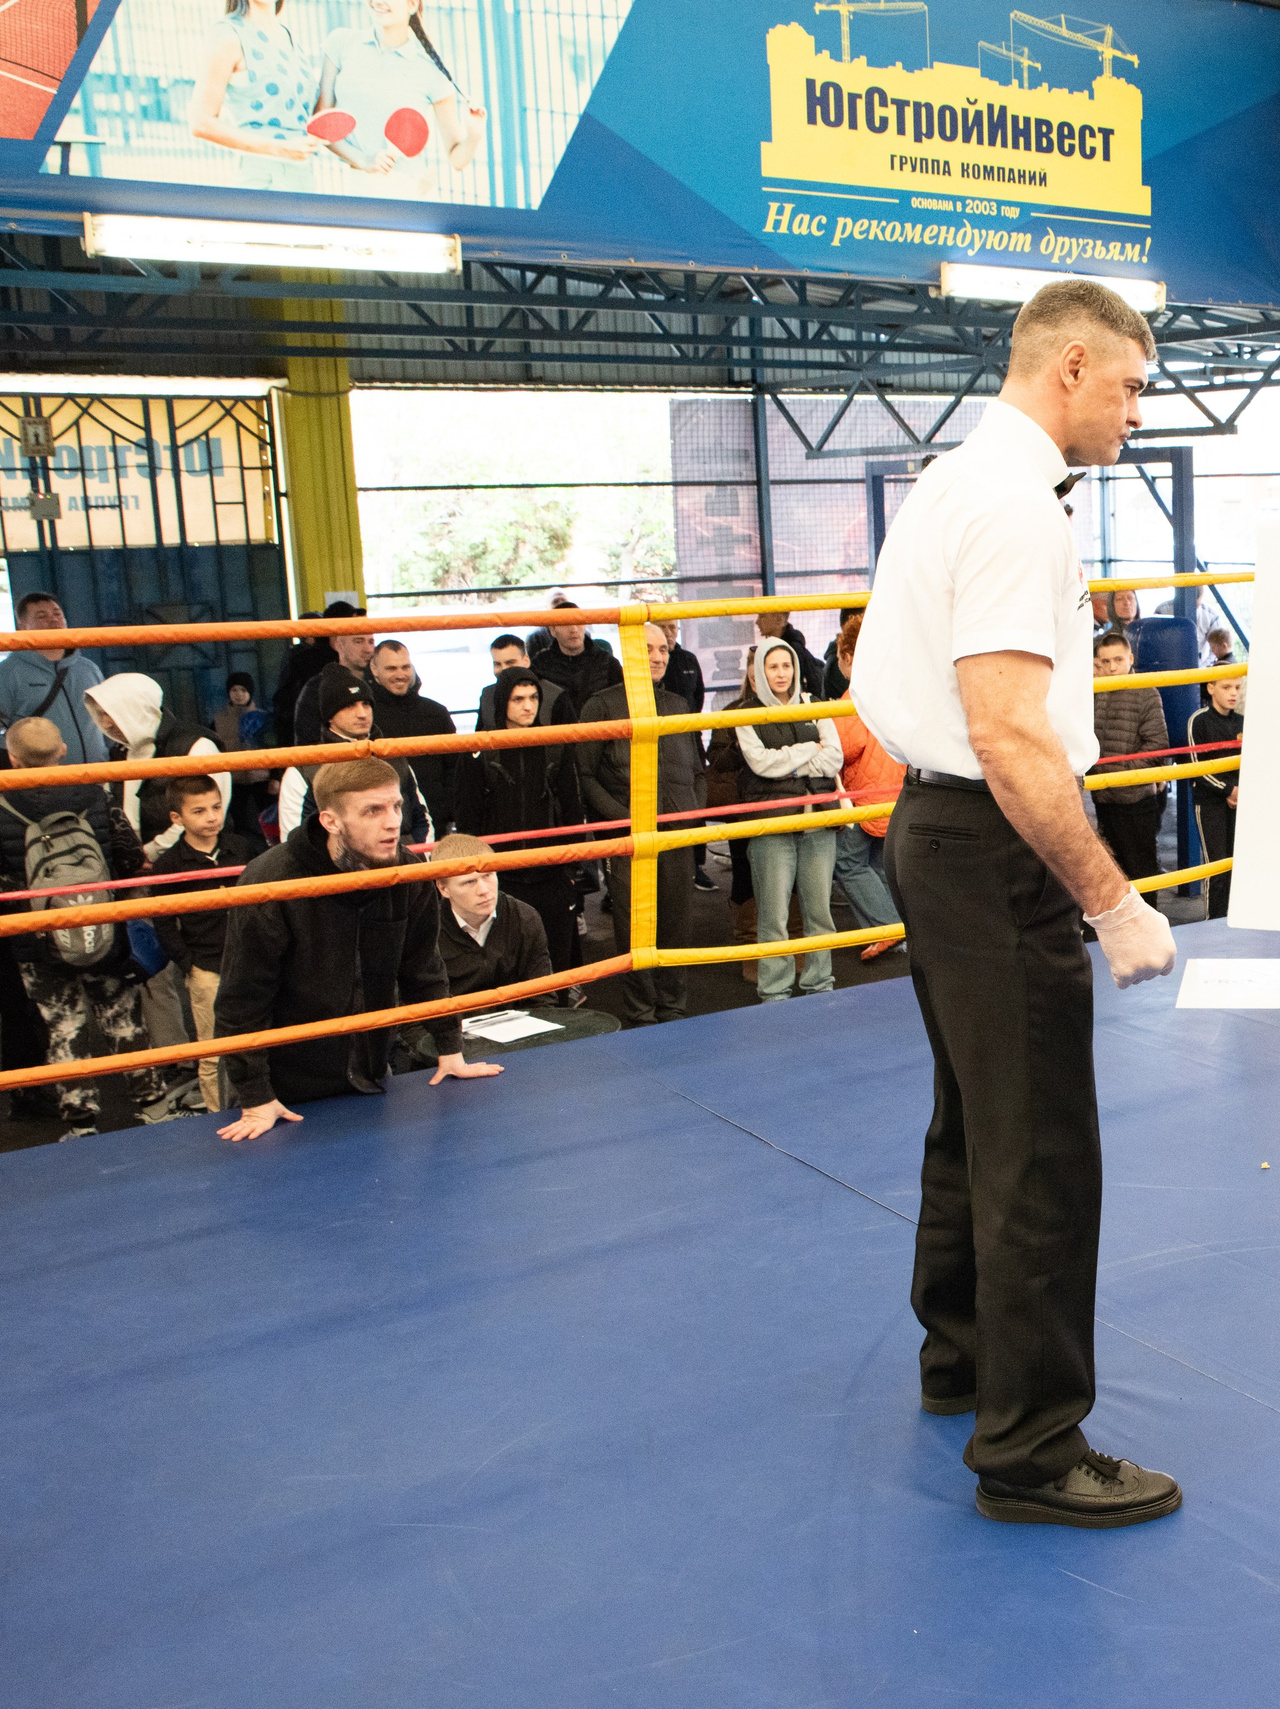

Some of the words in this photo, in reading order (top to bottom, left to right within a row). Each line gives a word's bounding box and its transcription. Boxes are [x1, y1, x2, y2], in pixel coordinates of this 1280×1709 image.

[804, 77, 1115, 162] ЮгСтройИнвест
[889, 154, 952, 178] ГРУППА
[960, 162, 1048, 188] КОМПАНИЙ
[911, 196, 954, 212] ОСНОВАНА
[956, 200, 963, 212] В
[965, 199, 997, 217] 2003
[762, 201, 827, 237] Нас
[830, 216, 1032, 257] рекомендуют
[1039, 226, 1152, 264] друзьям!
